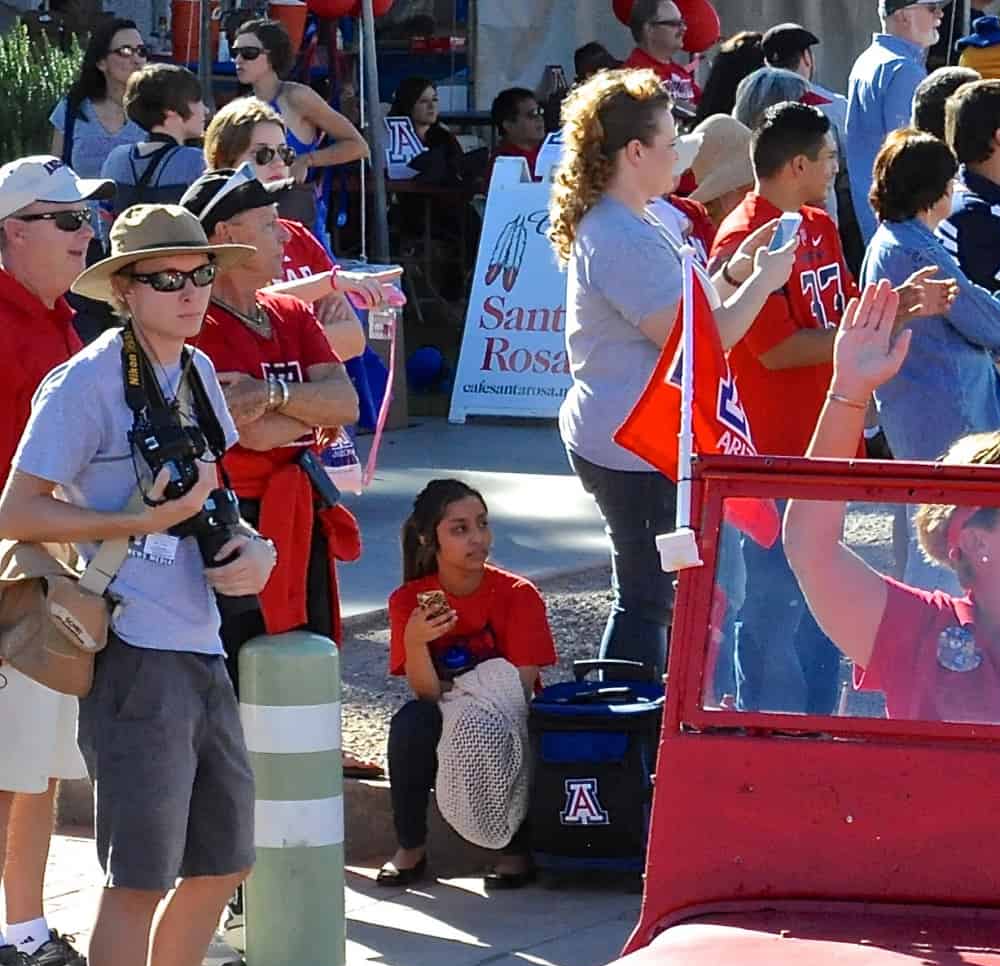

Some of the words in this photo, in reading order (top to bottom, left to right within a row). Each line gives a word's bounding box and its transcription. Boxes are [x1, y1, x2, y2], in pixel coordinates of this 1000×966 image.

[479, 295, 567, 333] Sant
[127, 353, 140, 386] Nikon
[479, 336, 571, 374] Rosa
[462, 379, 568, 397] cafesantarosa.n
[560, 778, 610, 825] A
